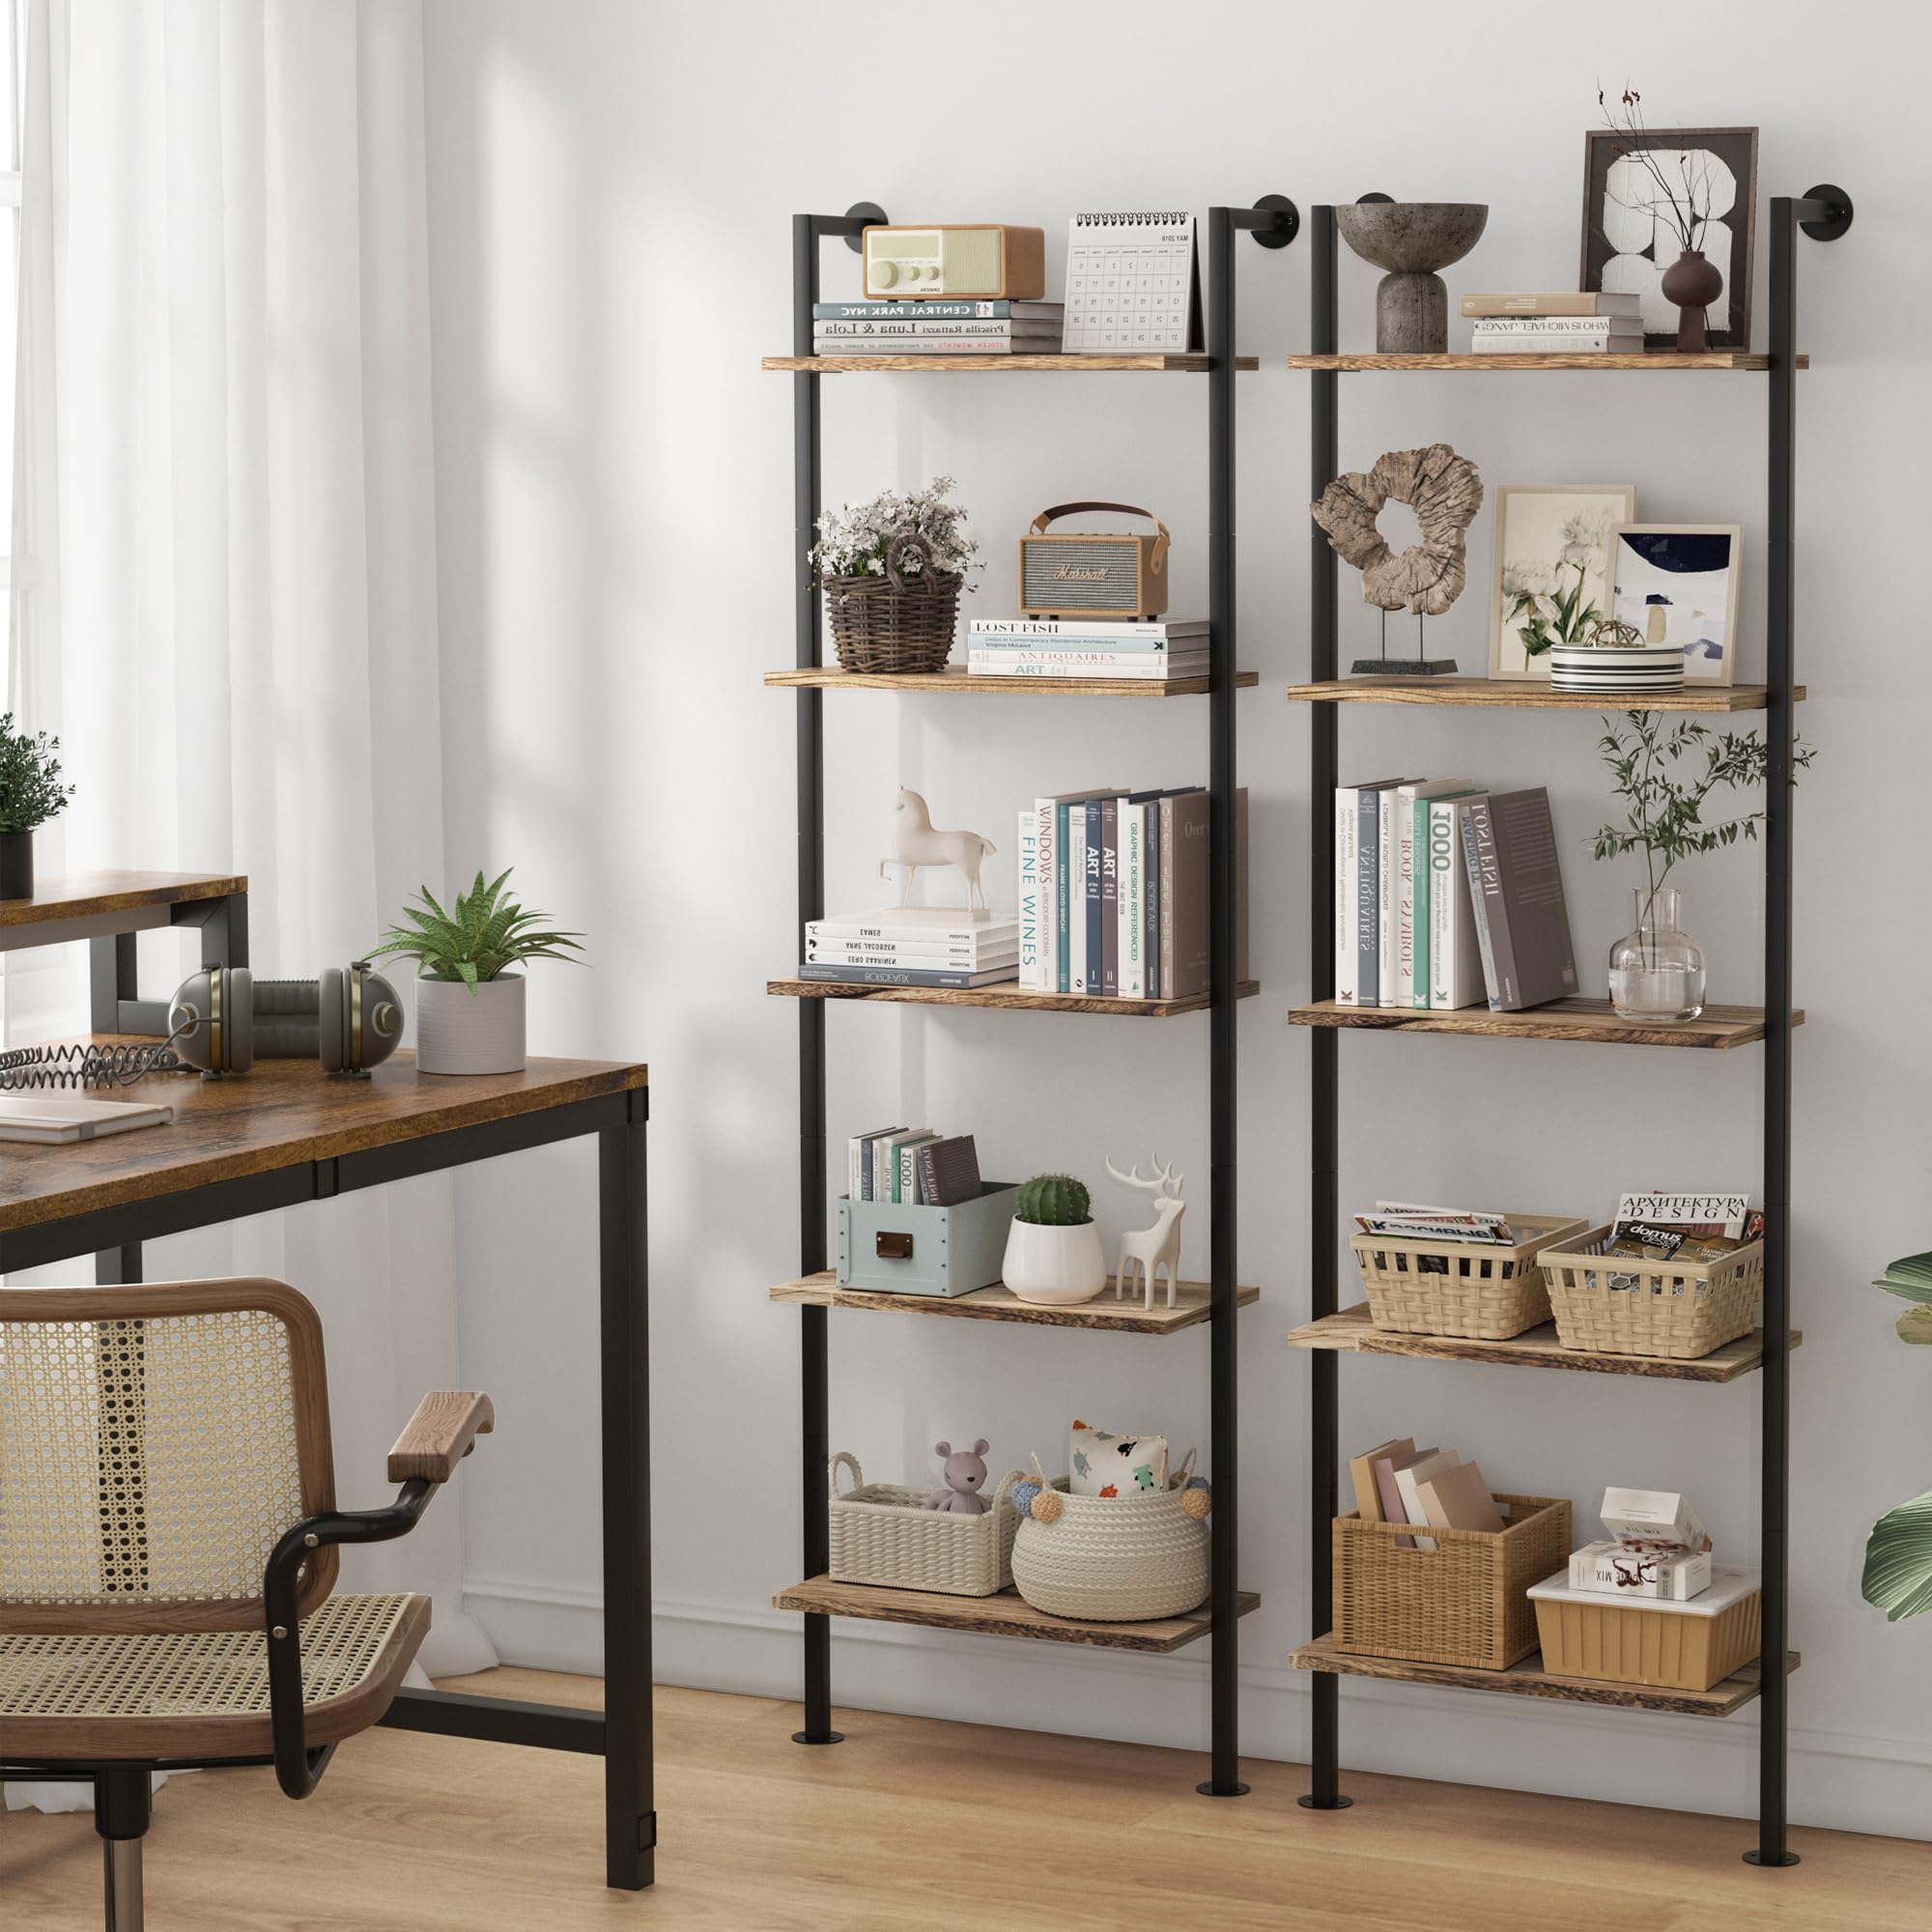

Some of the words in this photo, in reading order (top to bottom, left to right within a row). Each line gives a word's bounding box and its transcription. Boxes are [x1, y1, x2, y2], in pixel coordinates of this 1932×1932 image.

[1482, 323, 1520, 331] JANG?
[1053, 564, 1111, 581] Marshall
[976, 622, 1018, 634] LOST
[1023, 623, 1059, 634] FISH
[1018, 652, 1116, 663] ANTIQUAIRES
[1014, 665, 1045, 674] ART
[1184, 821, 1206, 838] Over
[1038, 806, 1053, 884] WINDOWS
[1022, 837, 1037, 884] FINE
[1087, 846, 1099, 877] ART
[1103, 846, 1116, 878] ART
[1022, 895, 1037, 966] WINES
[1623, 1197, 1746, 1208] АРХИТЕКТУРА
[1630, 1207, 1741, 1219] DESIGN
[1630, 1224, 1683, 1242] domus
[1641, 1233, 1682, 1249] design
[1596, 1570, 1612, 1582] MIX
